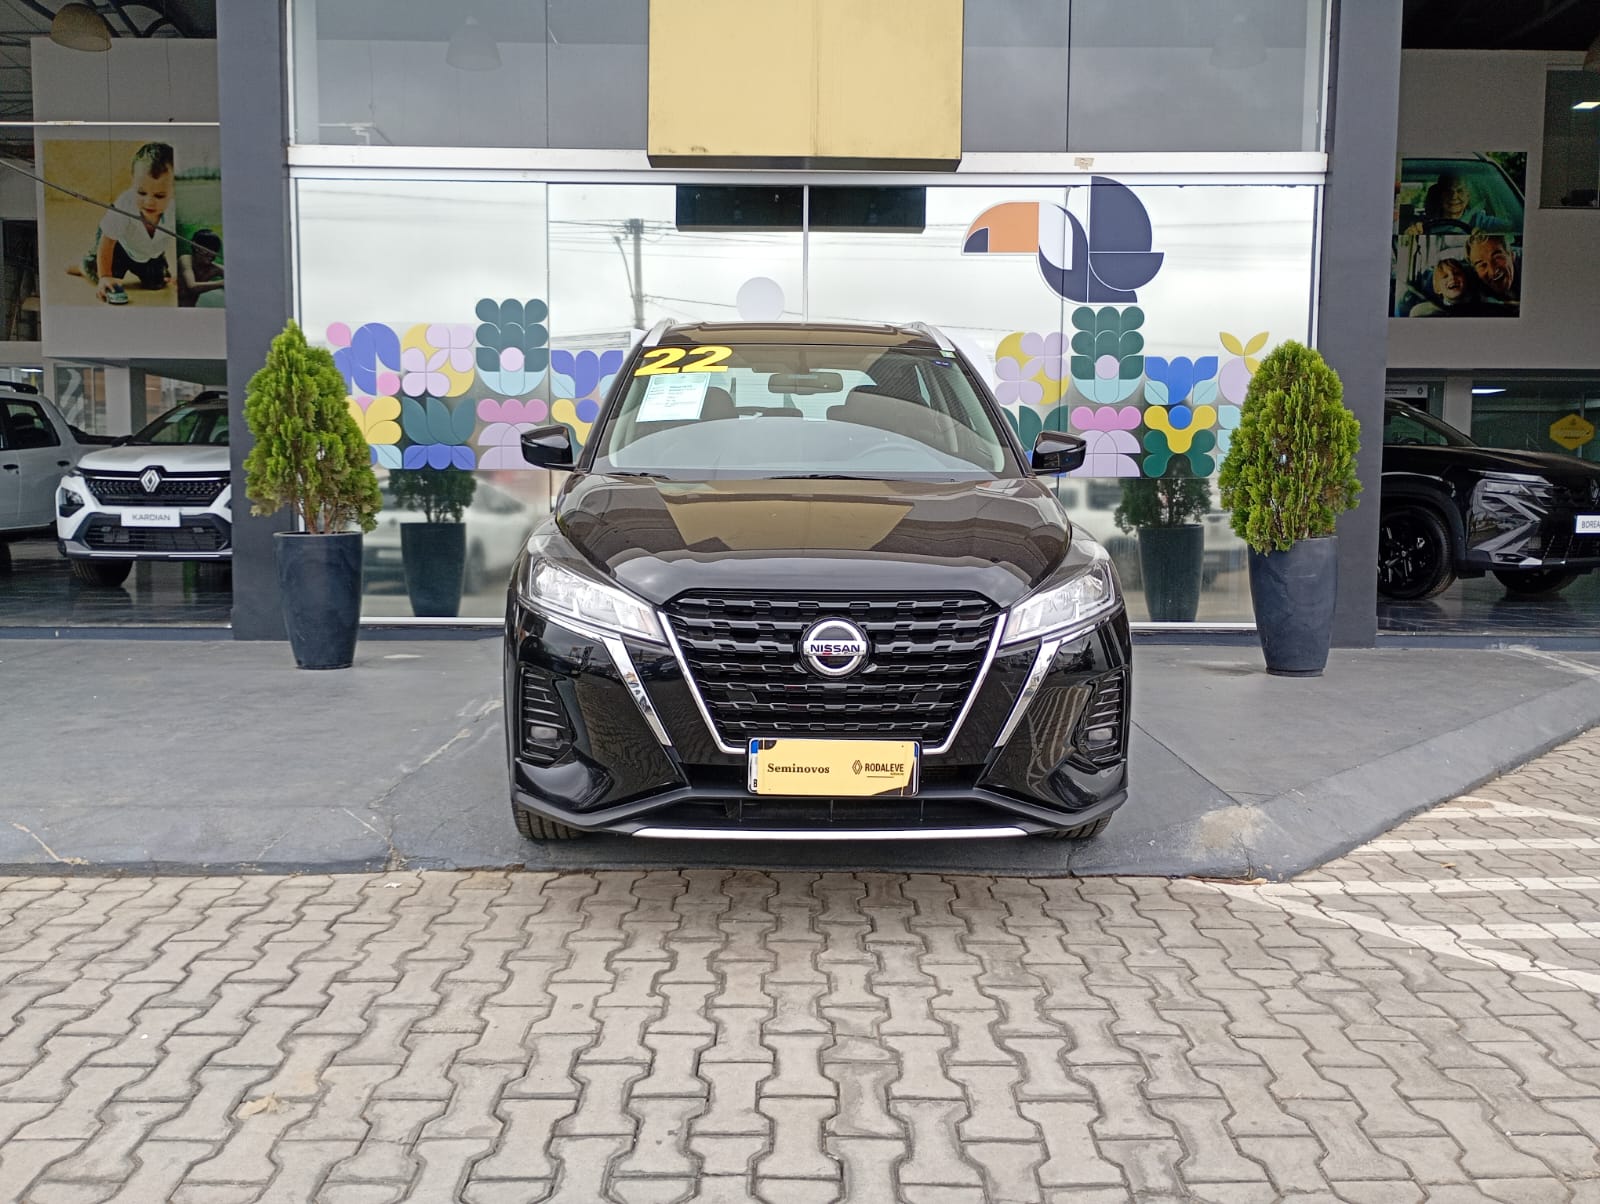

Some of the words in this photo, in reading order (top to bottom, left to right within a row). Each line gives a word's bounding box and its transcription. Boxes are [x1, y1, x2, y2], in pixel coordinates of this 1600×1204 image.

[633, 345, 733, 377] 22
[131, 513, 171, 521] KARDIAN
[810, 644, 860, 653] NISSAN
[767, 762, 830, 774] Seminovos
[864, 762, 904, 773] RODALEVE
